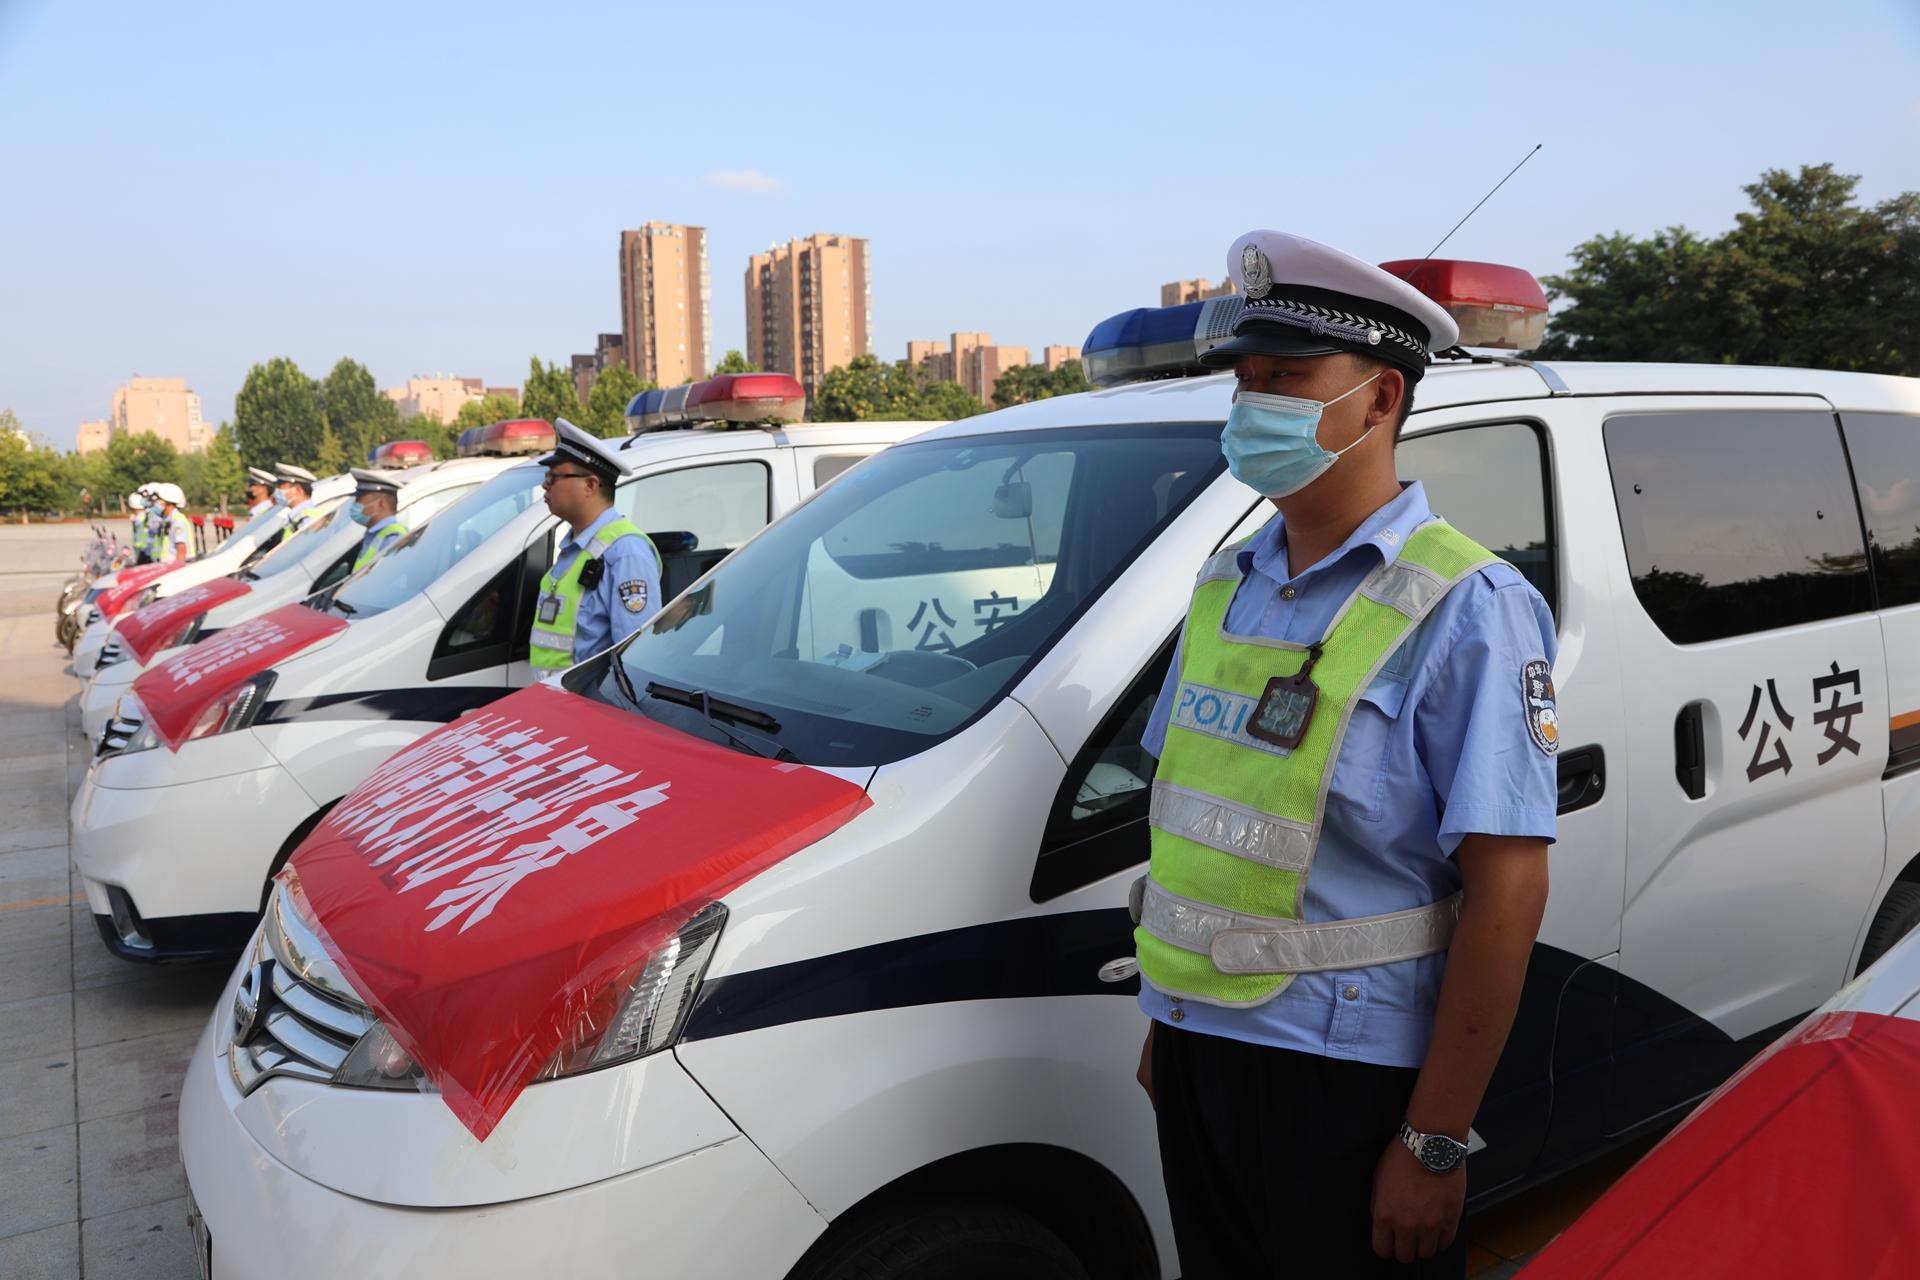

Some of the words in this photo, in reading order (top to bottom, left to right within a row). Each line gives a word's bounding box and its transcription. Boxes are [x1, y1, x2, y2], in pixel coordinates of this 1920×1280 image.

[906, 590, 1018, 653] 公安
[1177, 688, 1249, 734] POLI
[1738, 660, 1863, 783] 公安
